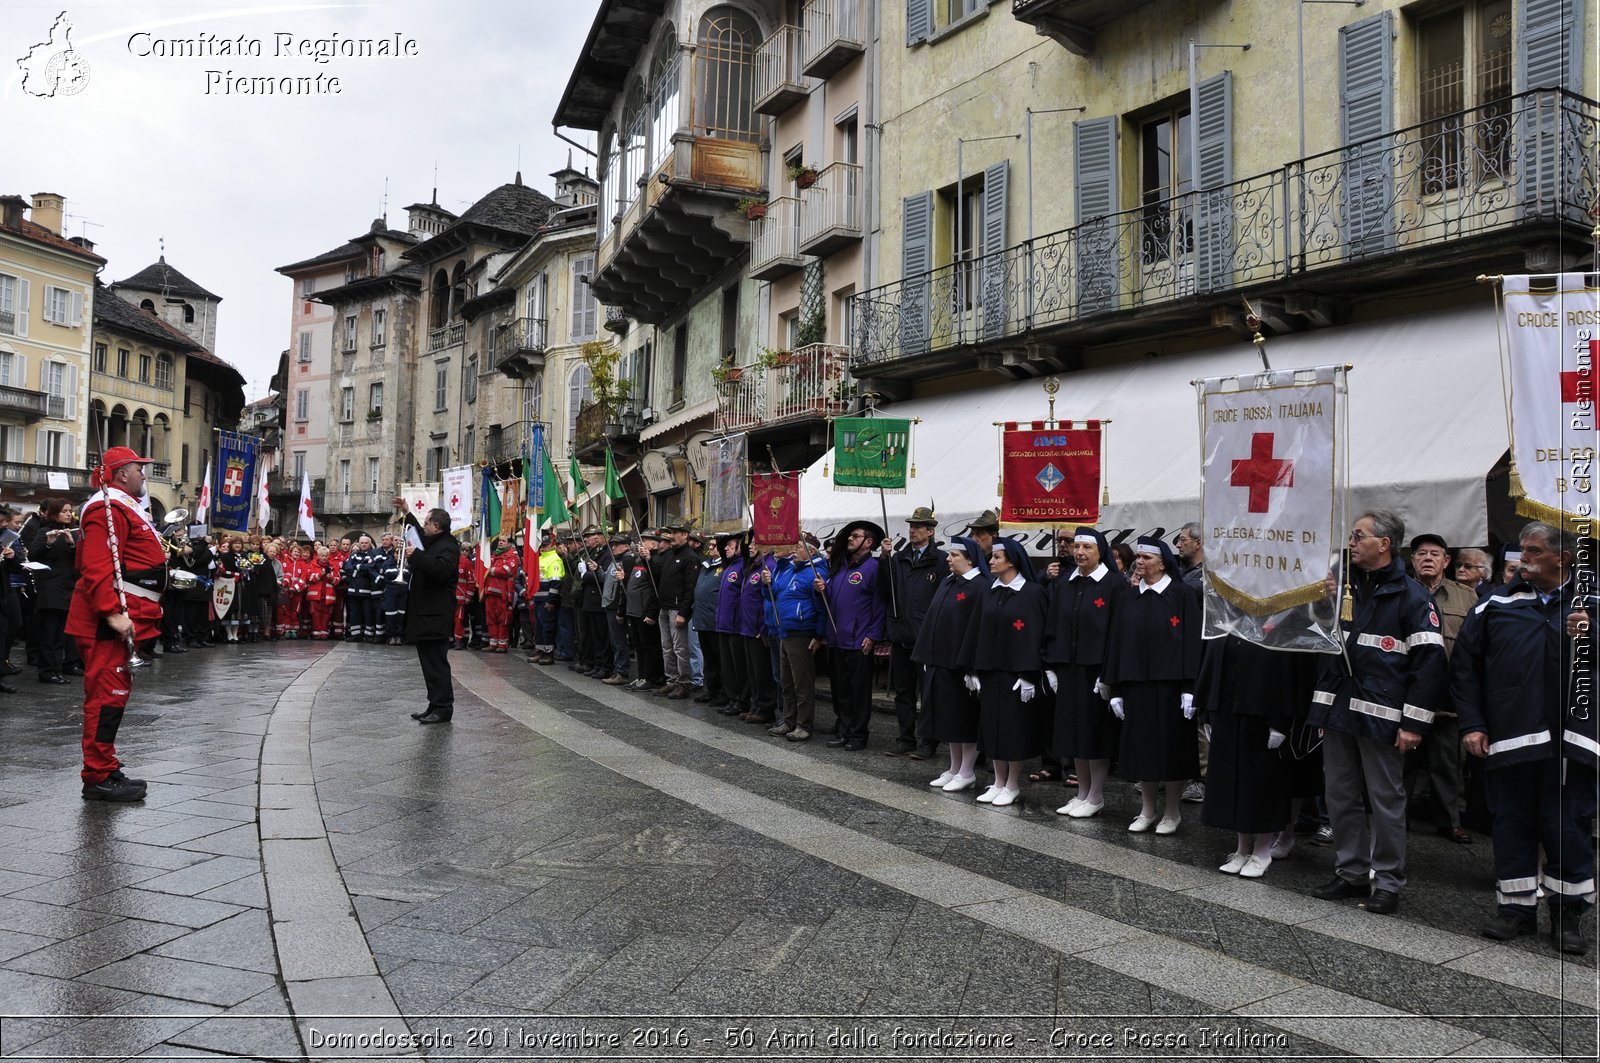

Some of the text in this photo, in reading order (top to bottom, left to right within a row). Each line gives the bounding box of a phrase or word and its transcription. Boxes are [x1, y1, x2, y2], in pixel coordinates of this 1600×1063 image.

[1517, 312, 1558, 328] CROCE
[1213, 402, 1323, 423] CROCE ROSSA ITALIANA
[1034, 436, 1067, 446] AVIS
[1012, 508, 1089, 516] DOMODOSSOLA
[1213, 527, 1316, 543] DELEGAZIONE DI
[1223, 552, 1303, 572] ANTRONA
